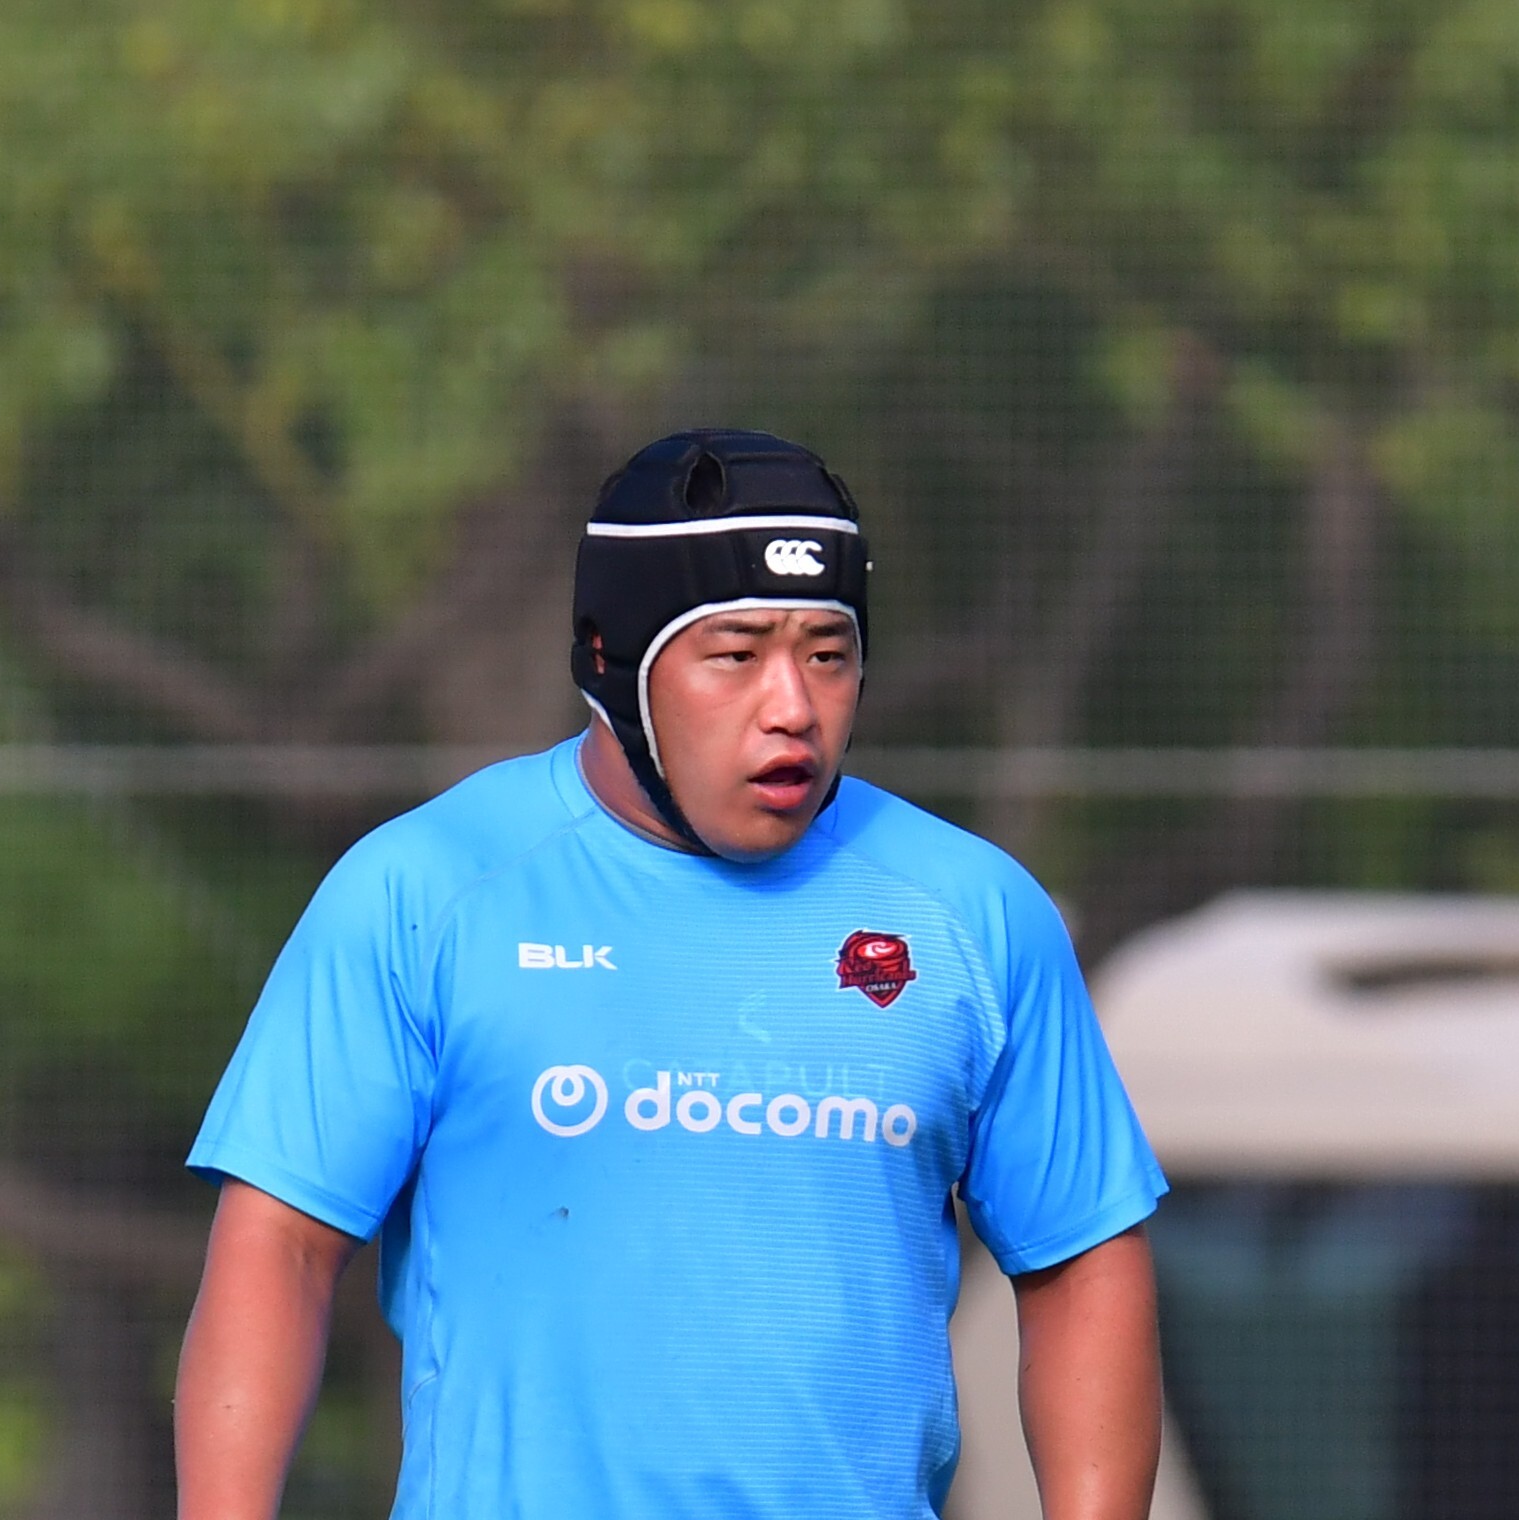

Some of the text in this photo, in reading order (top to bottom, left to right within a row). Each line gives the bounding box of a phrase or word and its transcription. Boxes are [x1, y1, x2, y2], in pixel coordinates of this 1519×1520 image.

[518, 942, 618, 970] BLK
[677, 1071, 720, 1087] NTT
[624, 1070, 917, 1147] docomo
